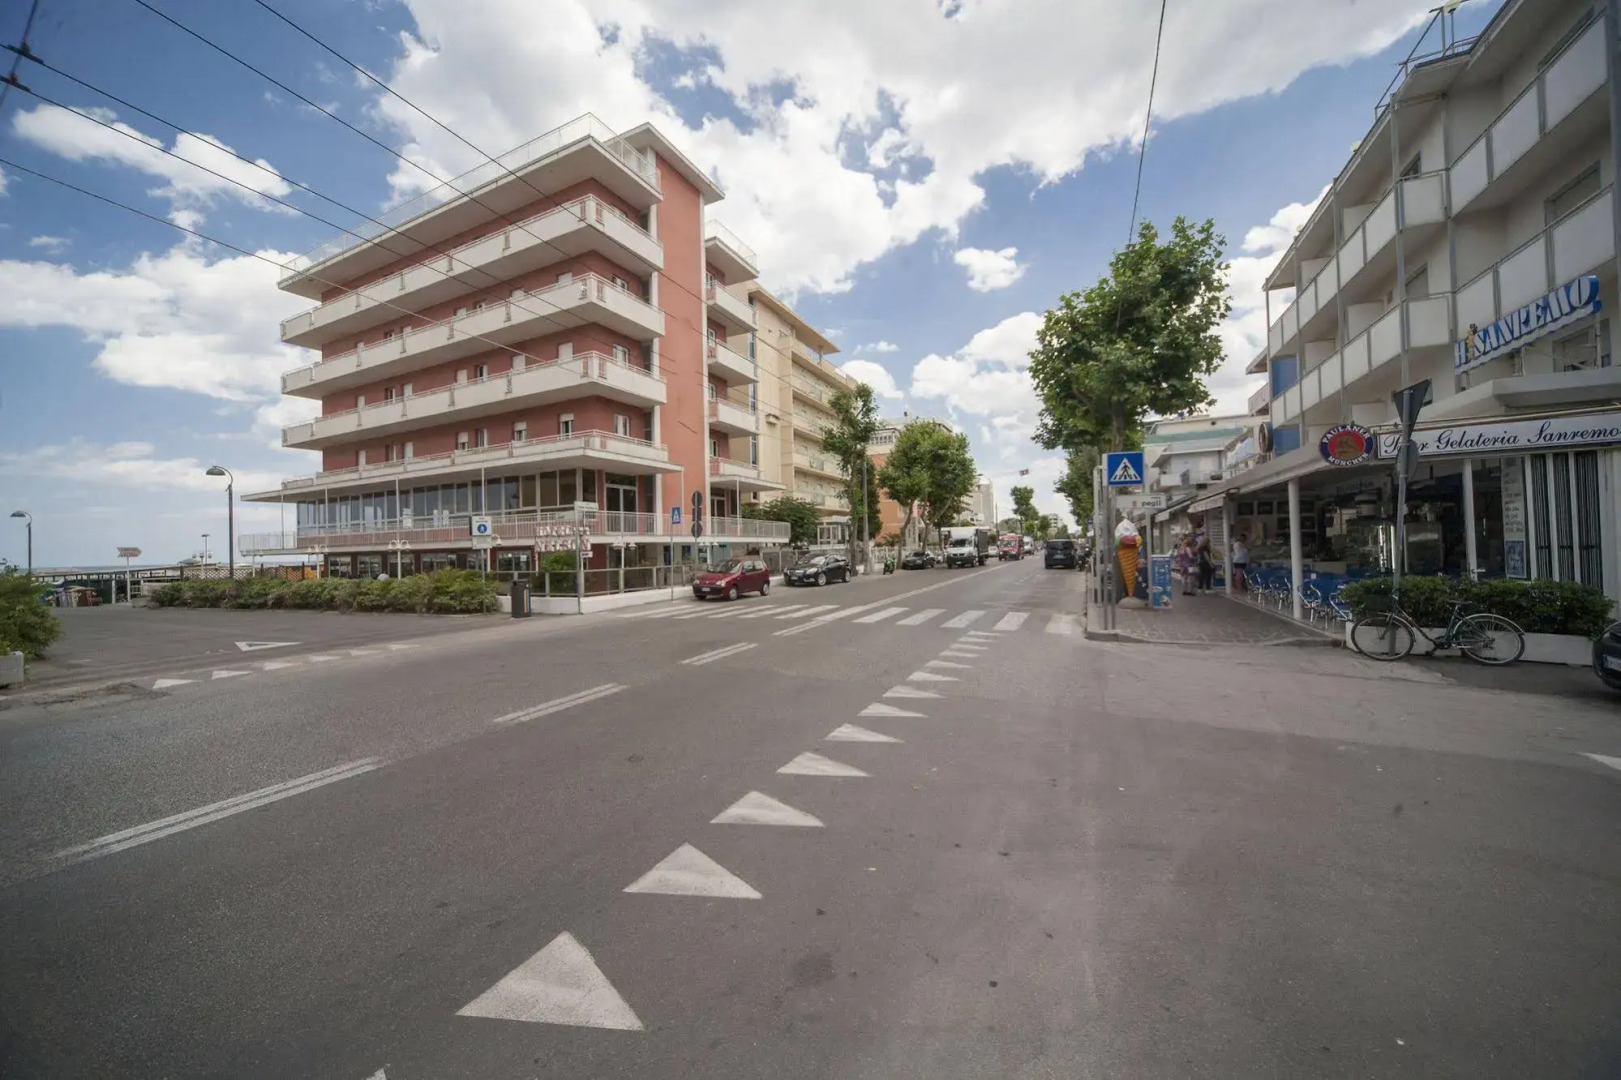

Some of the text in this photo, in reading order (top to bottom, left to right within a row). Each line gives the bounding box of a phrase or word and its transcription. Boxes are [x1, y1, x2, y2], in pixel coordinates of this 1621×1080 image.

[1473, 275, 1598, 358] SANREMO
[1321, 424, 1371, 443] PAULANER
[1436, 429, 1519, 450] Gelateria
[1527, 421, 1621, 444] Sanremo
